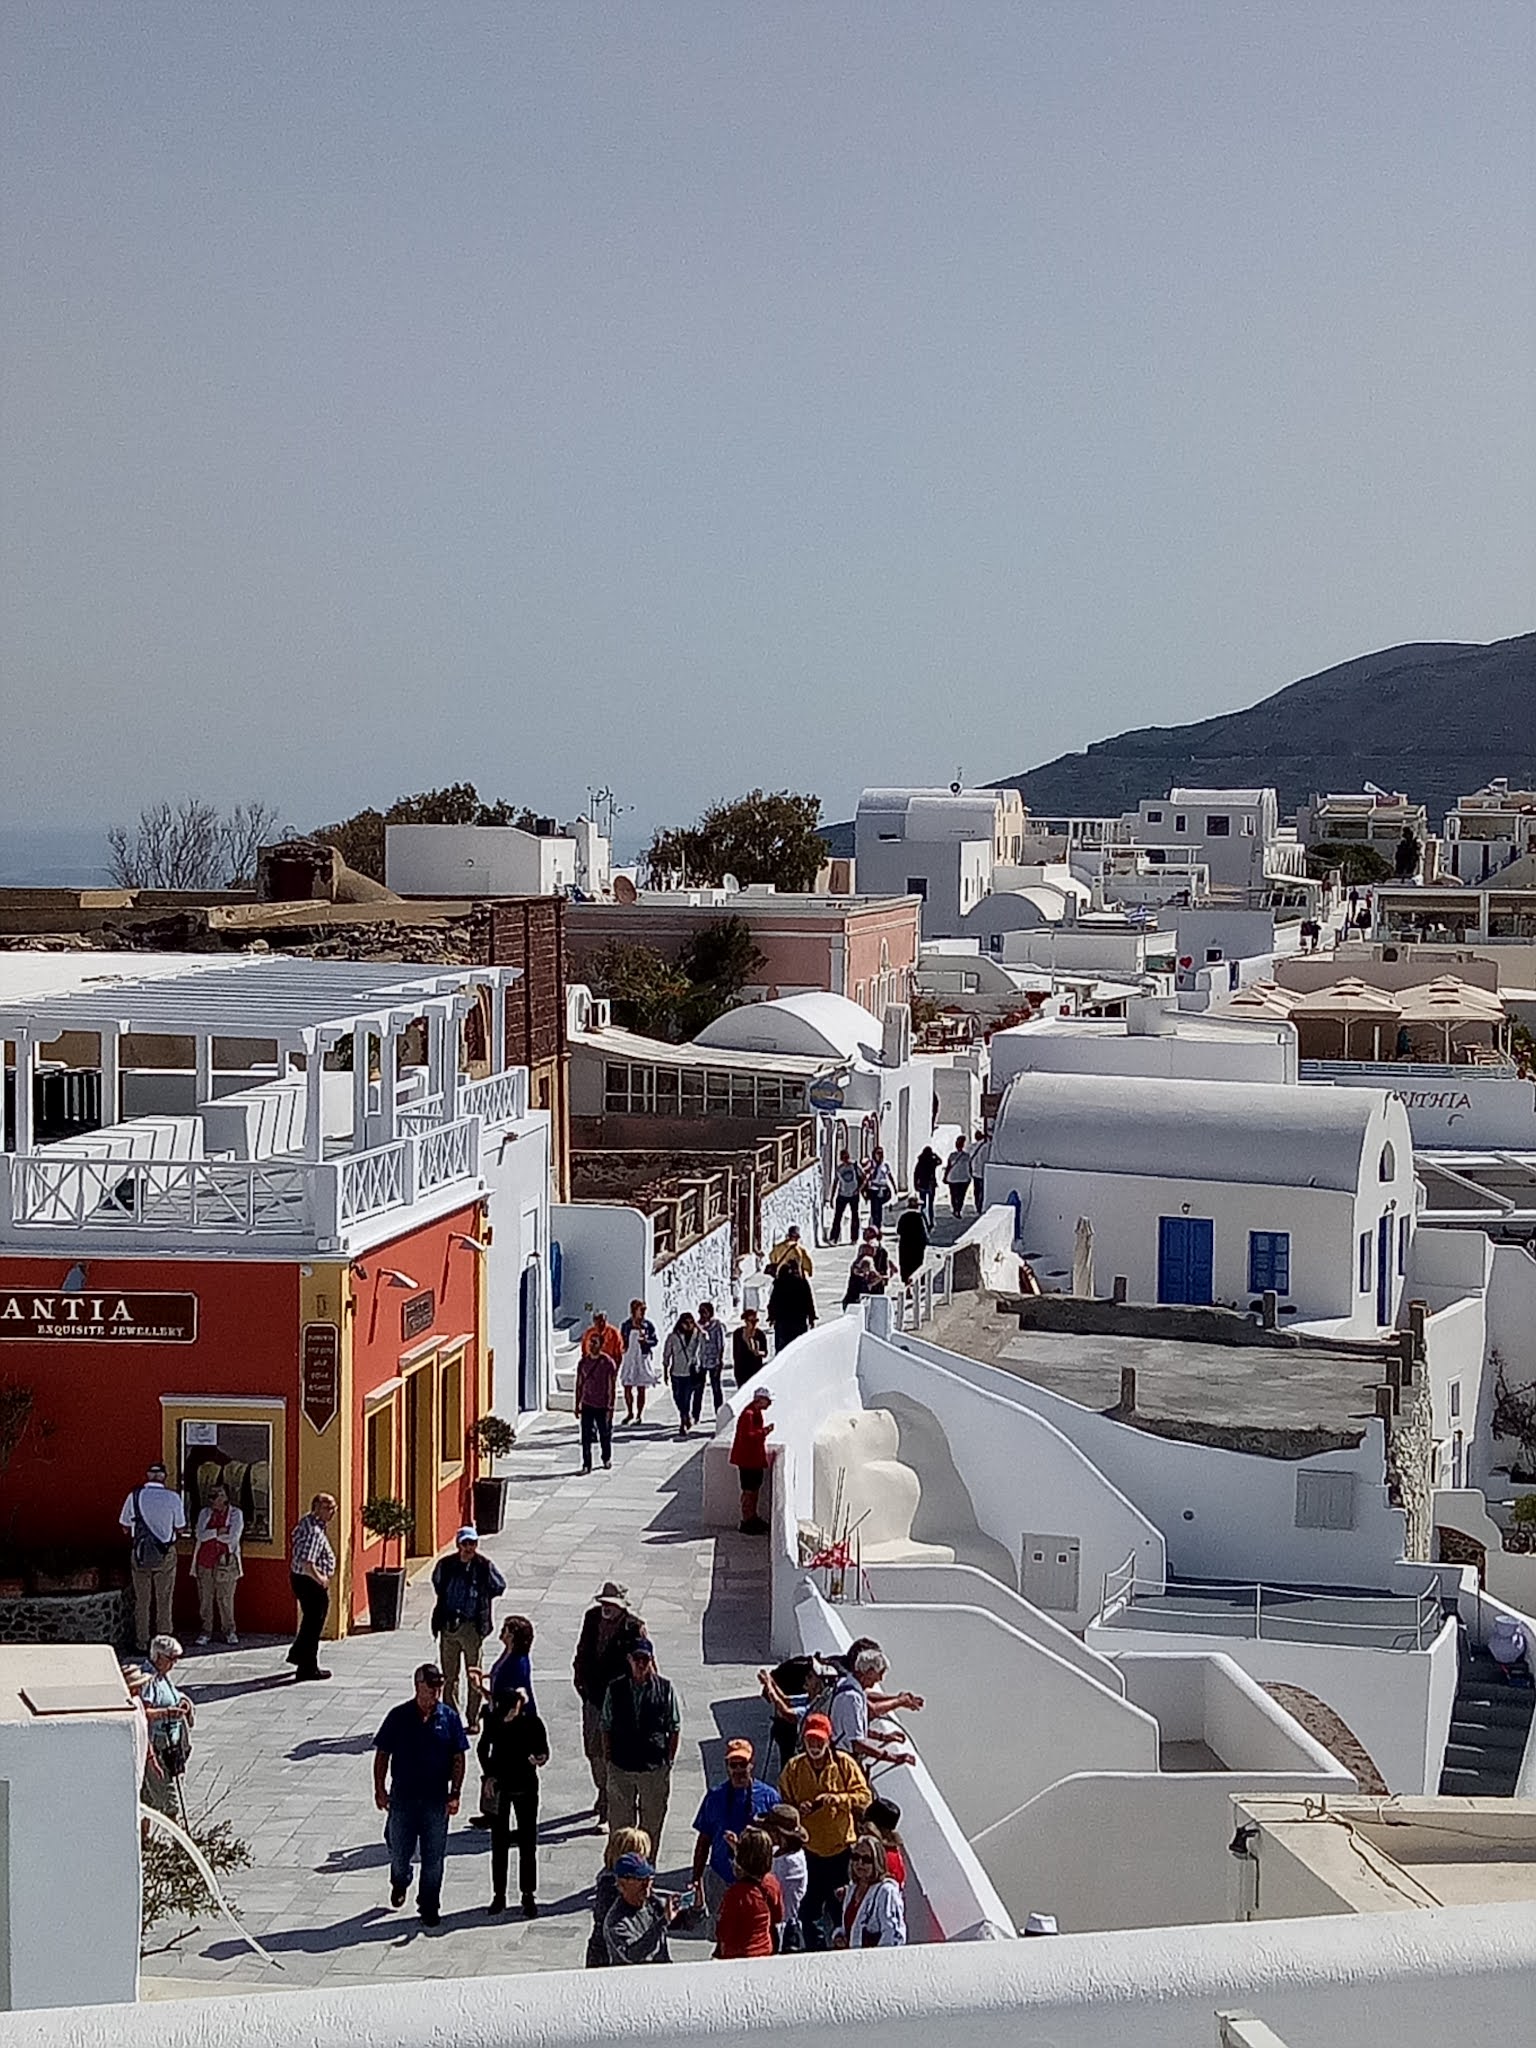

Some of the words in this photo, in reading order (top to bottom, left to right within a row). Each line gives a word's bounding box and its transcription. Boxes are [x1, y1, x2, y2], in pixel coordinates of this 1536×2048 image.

[0, 1298, 134, 1321] ANTIA
[38, 1325, 105, 1336] EXQUISITE
[110, 1327, 185, 1337] JEWELLERY
